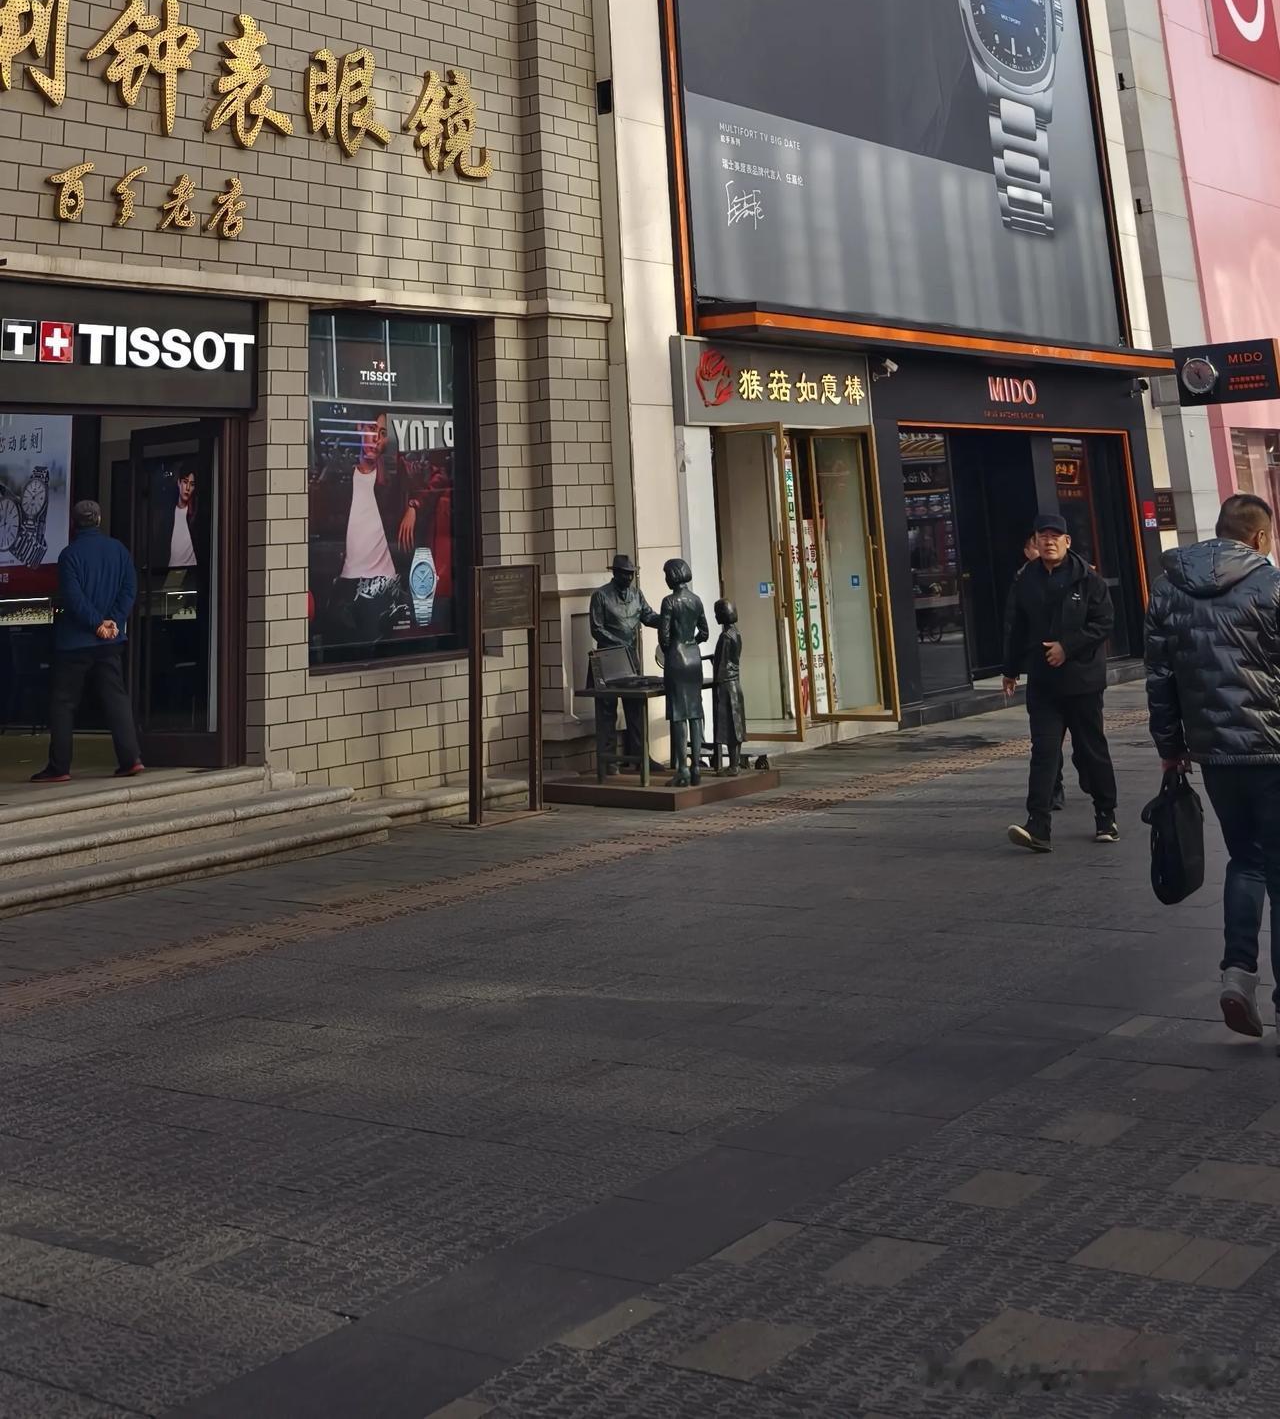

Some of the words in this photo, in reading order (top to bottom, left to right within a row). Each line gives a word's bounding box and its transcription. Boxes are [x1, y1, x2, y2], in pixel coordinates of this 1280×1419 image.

[719, 122, 758, 139] MULTIFORT
[760, 132, 769, 142] TV
[770, 135, 782, 146] BIG
[784, 138, 801, 151] DATE
[78, 323, 255, 371] TISSOT
[1227, 351, 1263, 363] MIDO
[360, 371, 397, 382] TISSOT
[738, 368, 866, 406] 猴菇如意棒
[987, 376, 1037, 405] MIDO
